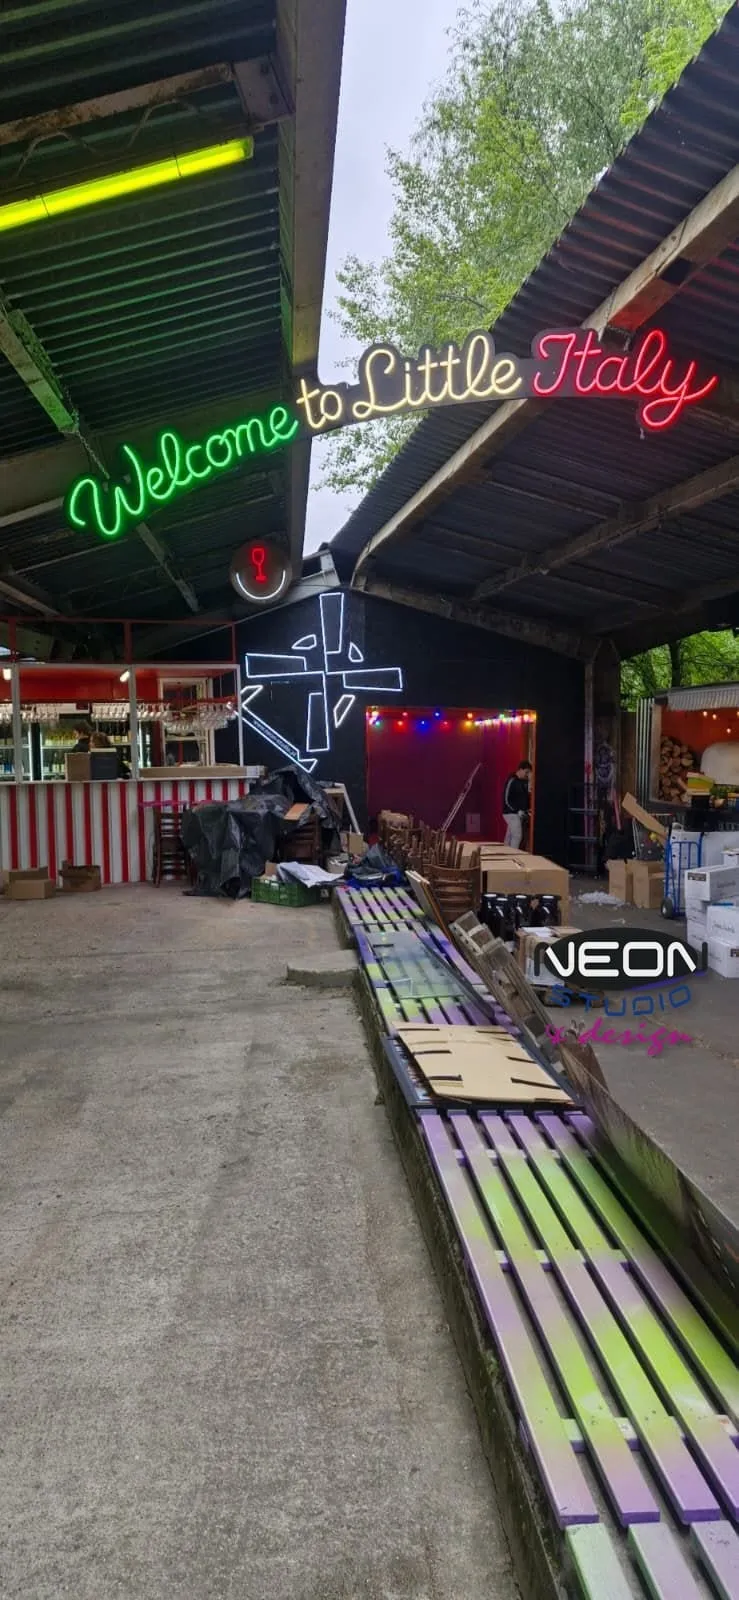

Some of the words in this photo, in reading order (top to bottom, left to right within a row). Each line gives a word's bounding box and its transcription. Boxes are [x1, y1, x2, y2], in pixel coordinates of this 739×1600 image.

[68, 404, 299, 537] Welcome
[297, 379, 343, 429] to
[352, 334, 522, 418] Little
[531, 329, 718, 429] Italy
